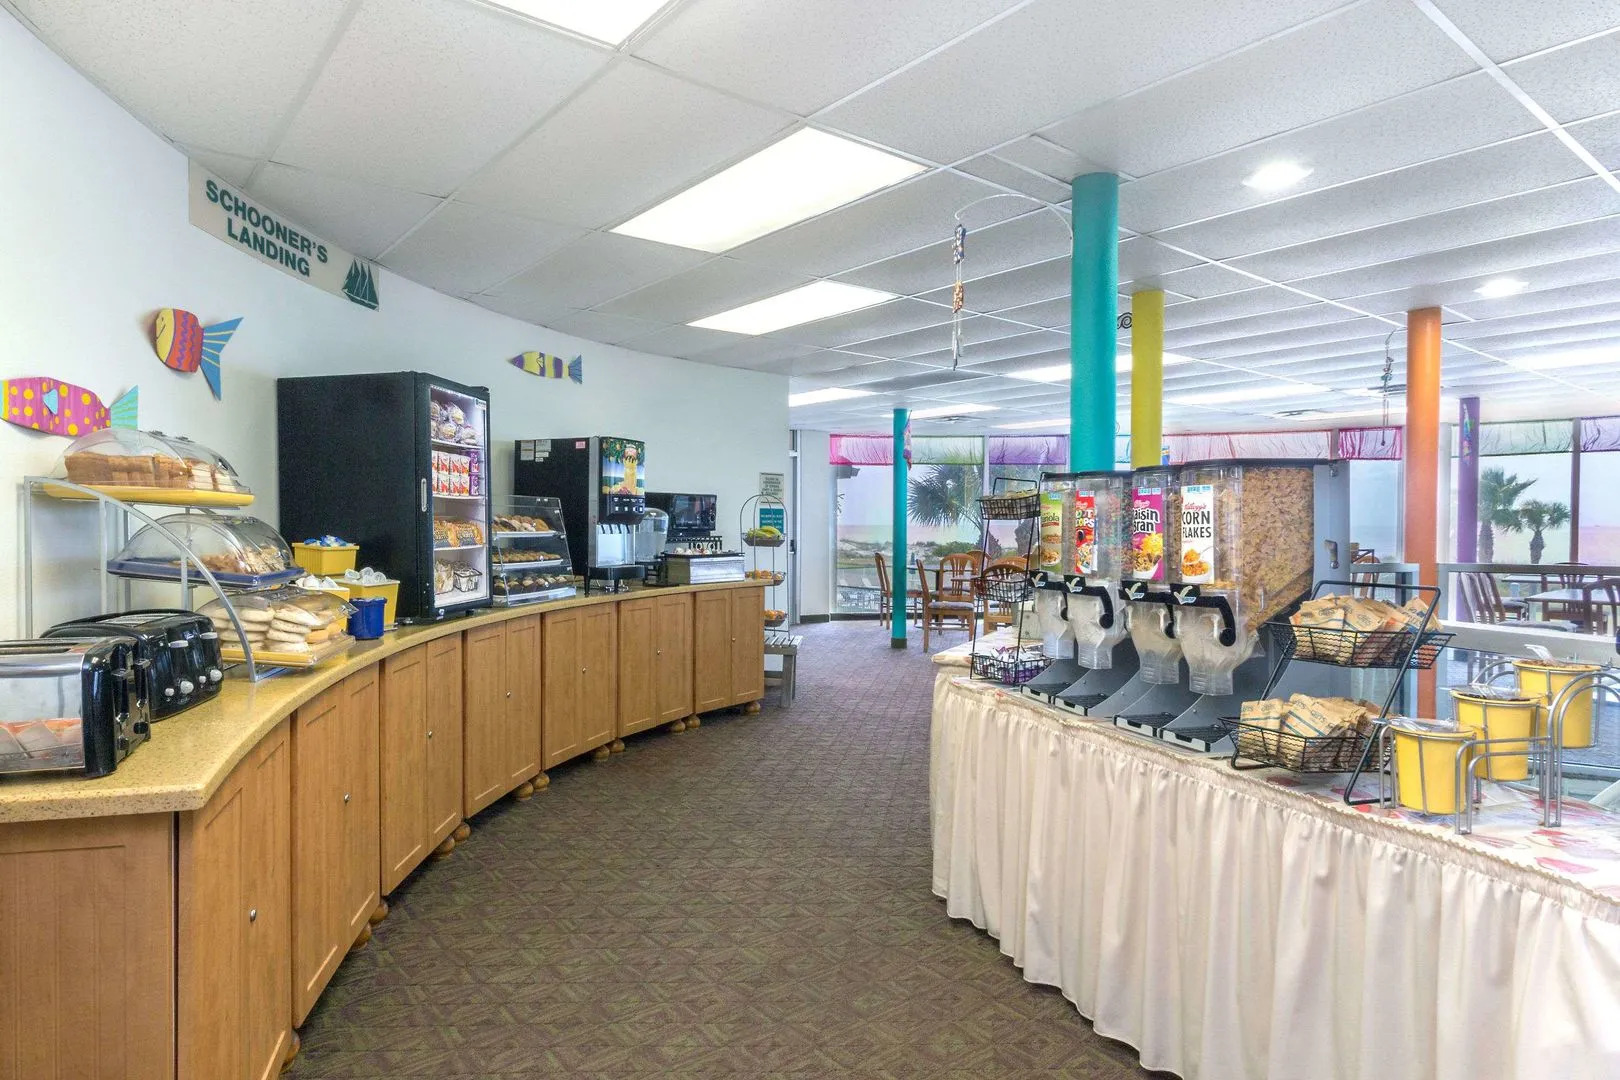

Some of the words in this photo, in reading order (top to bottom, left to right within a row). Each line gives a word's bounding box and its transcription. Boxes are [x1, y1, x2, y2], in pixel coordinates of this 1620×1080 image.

[206, 179, 328, 264] SCHOONER'S
[227, 217, 310, 277] LANDING
[1133, 508, 1159, 522] aisin
[1182, 526, 1212, 539] FLAKES
